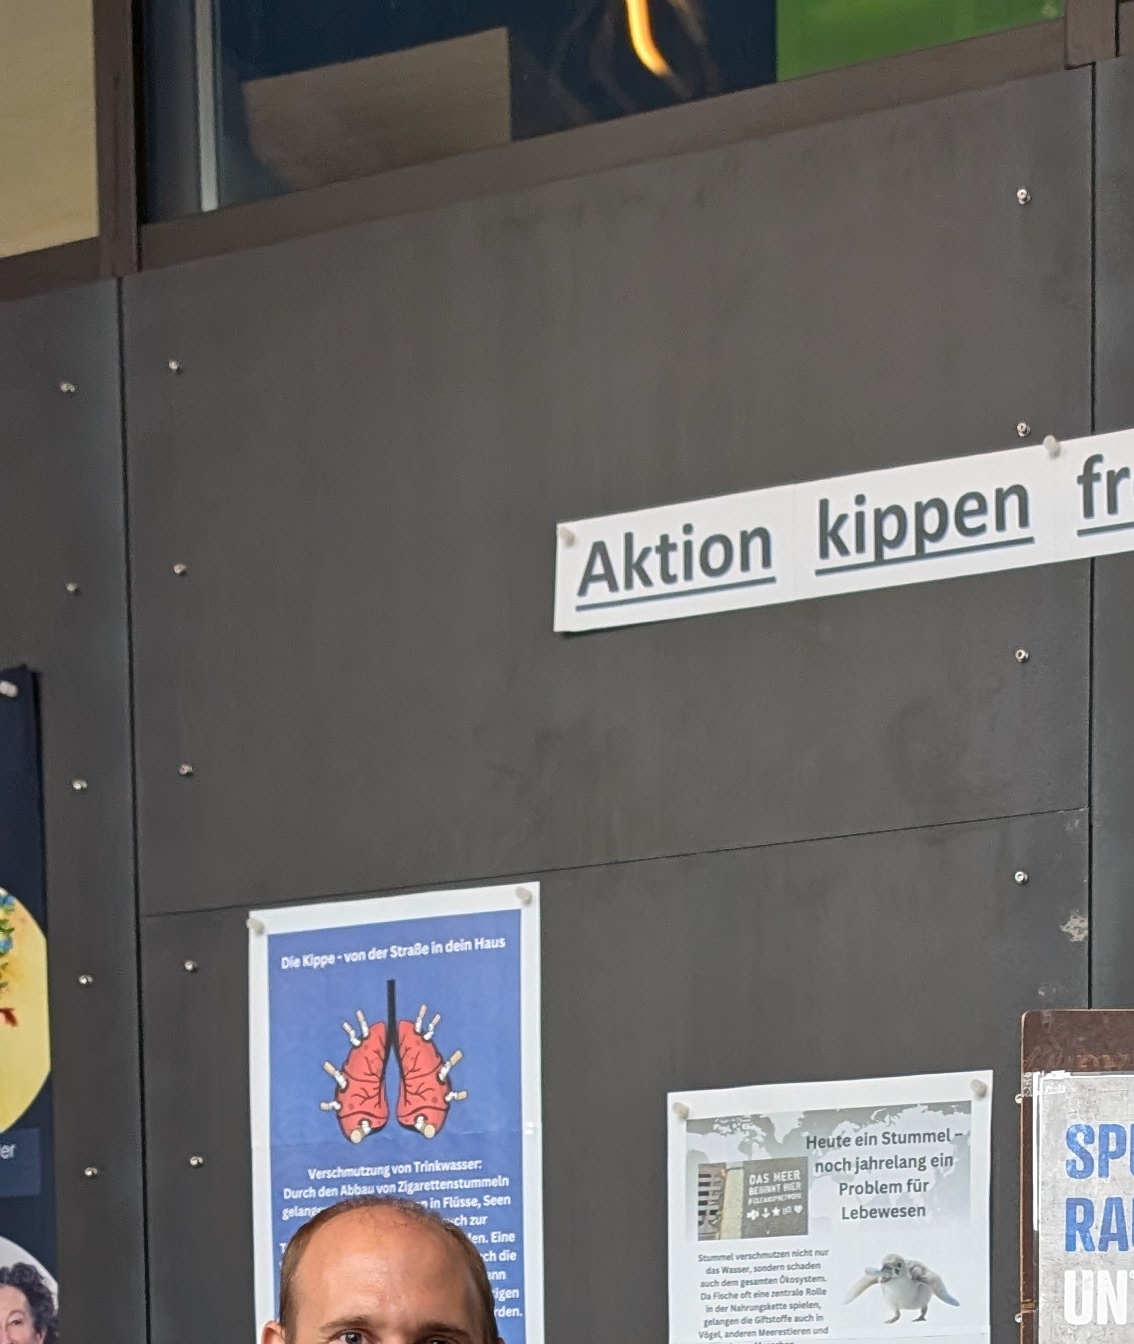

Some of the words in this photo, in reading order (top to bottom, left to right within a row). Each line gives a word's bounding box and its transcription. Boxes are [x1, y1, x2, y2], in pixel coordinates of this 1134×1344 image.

[577, 523, 772, 597] Aktion
[818, 482, 1029, 561] kippen
[280, 955, 301, 969] Die
[301, 953, 335, 969] Kippe
[343, 950, 366, 963] von
[367, 946, 388, 960] der
[389, 942, 429, 958] Straße
[430, 940, 443, 954] in
[444, 937, 472, 953] dein
[473, 936, 506, 950] Haus
[805, 1134, 851, 1150] Heute
[854, 1131, 877, 1146] ein
[881, 1129, 951, 1145] Stummel
[307, 1164, 391, 1180] Verschmutzung
[390, 1163, 412, 1174] von
[412, 1159, 483, 1173] Trinkwasser:
[814, 1157, 852, 1173] noch
[854, 1155, 927, 1173] jahrelang
[930, 1153, 954, 1168] ein
[283, 1185, 316, 1199] Durch
[317, 1185, 338, 1198] den
[339, 1183, 375, 1196] Abbau
[375, 1183, 396, 1194] von
[397, 1174, 509, 1194] Zigarettenstummeln
[838, 1180, 902, 1196] Problem
[905, 1178, 930, 1193] für
[841, 1205, 926, 1220] Lebewesen
